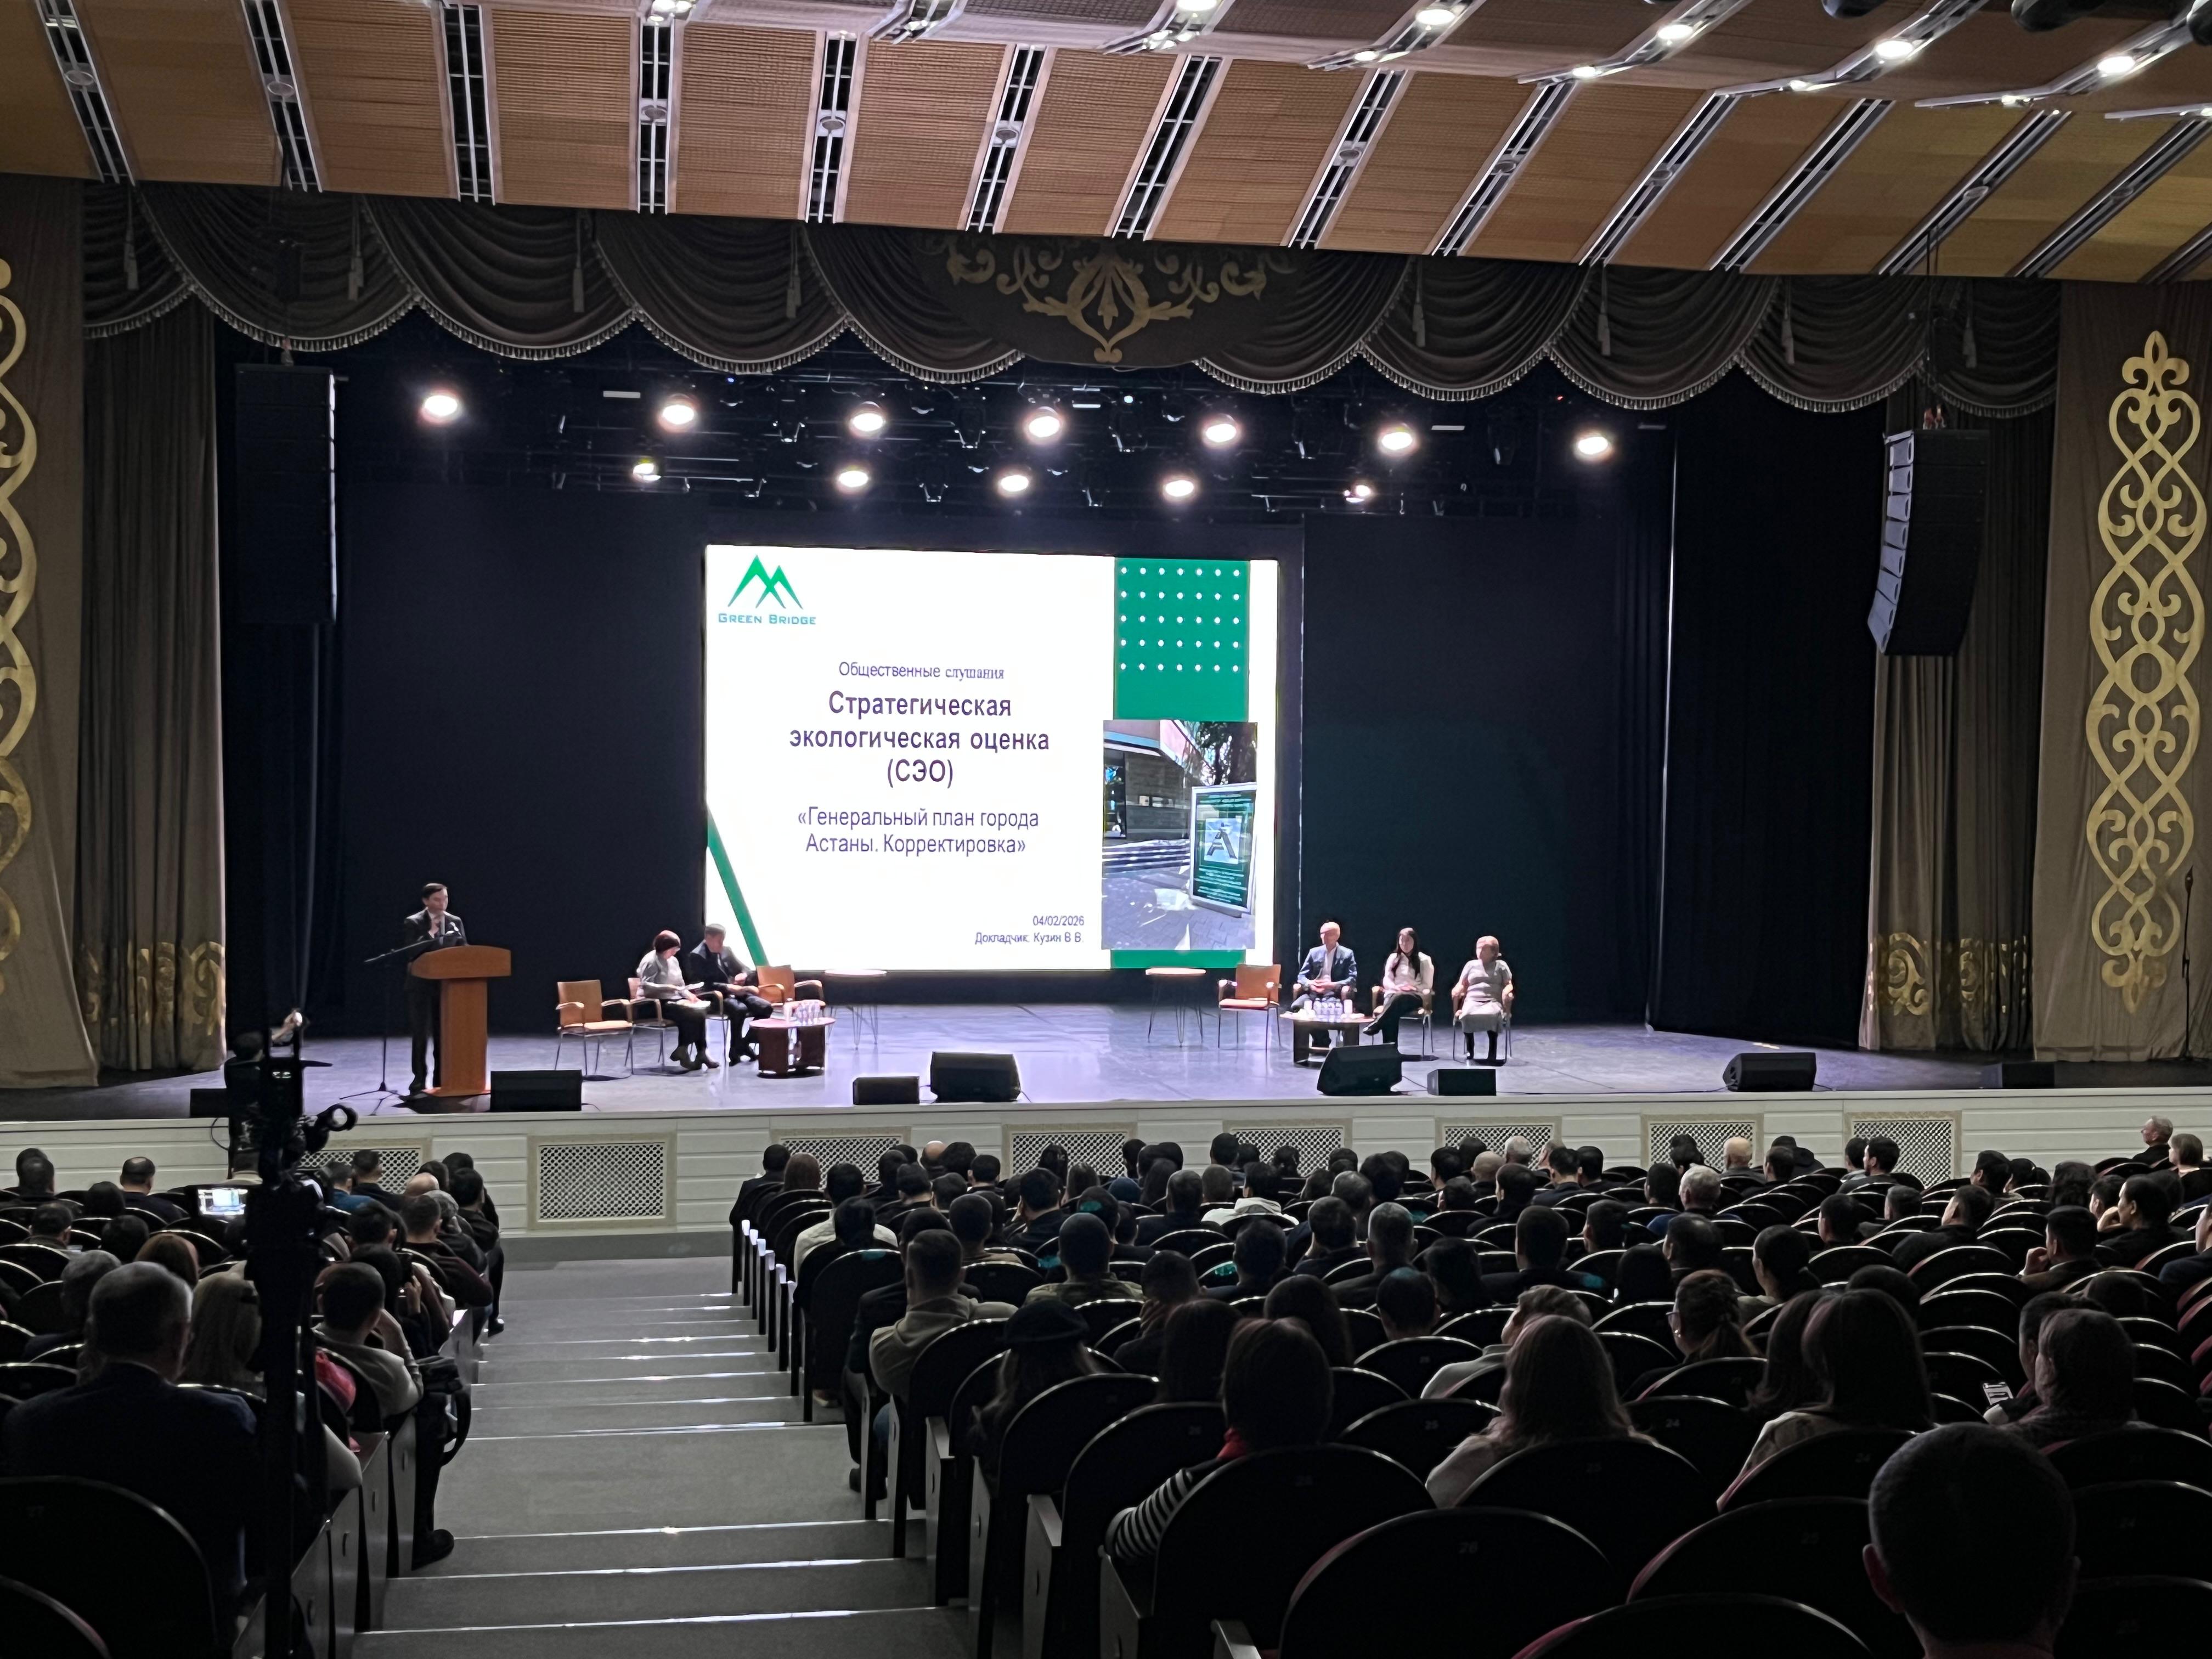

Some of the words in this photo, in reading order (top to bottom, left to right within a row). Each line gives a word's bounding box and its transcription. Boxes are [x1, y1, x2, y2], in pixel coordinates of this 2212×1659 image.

[718, 613, 762, 624] GREEN
[769, 614, 817, 625] BRIDGE
[839, 662, 940, 678] Общественные
[945, 669, 1004, 681] слушания
[829, 690, 1011, 720] Стратегическая
[789, 729, 960, 749] экологическая
[970, 732, 1049, 754] оценка
[887, 759, 953, 789] (СЭО)
[798, 806, 928, 831] «Генеральный
[933, 812, 974, 827] план
[981, 812, 1039, 831] города
[805, 833, 878, 852] Астаны.
[884, 834, 1026, 857] Корректировка»
[1032, 915, 1085, 926] 04/02/2026
[1034, 932, 1062, 945] Кузин
